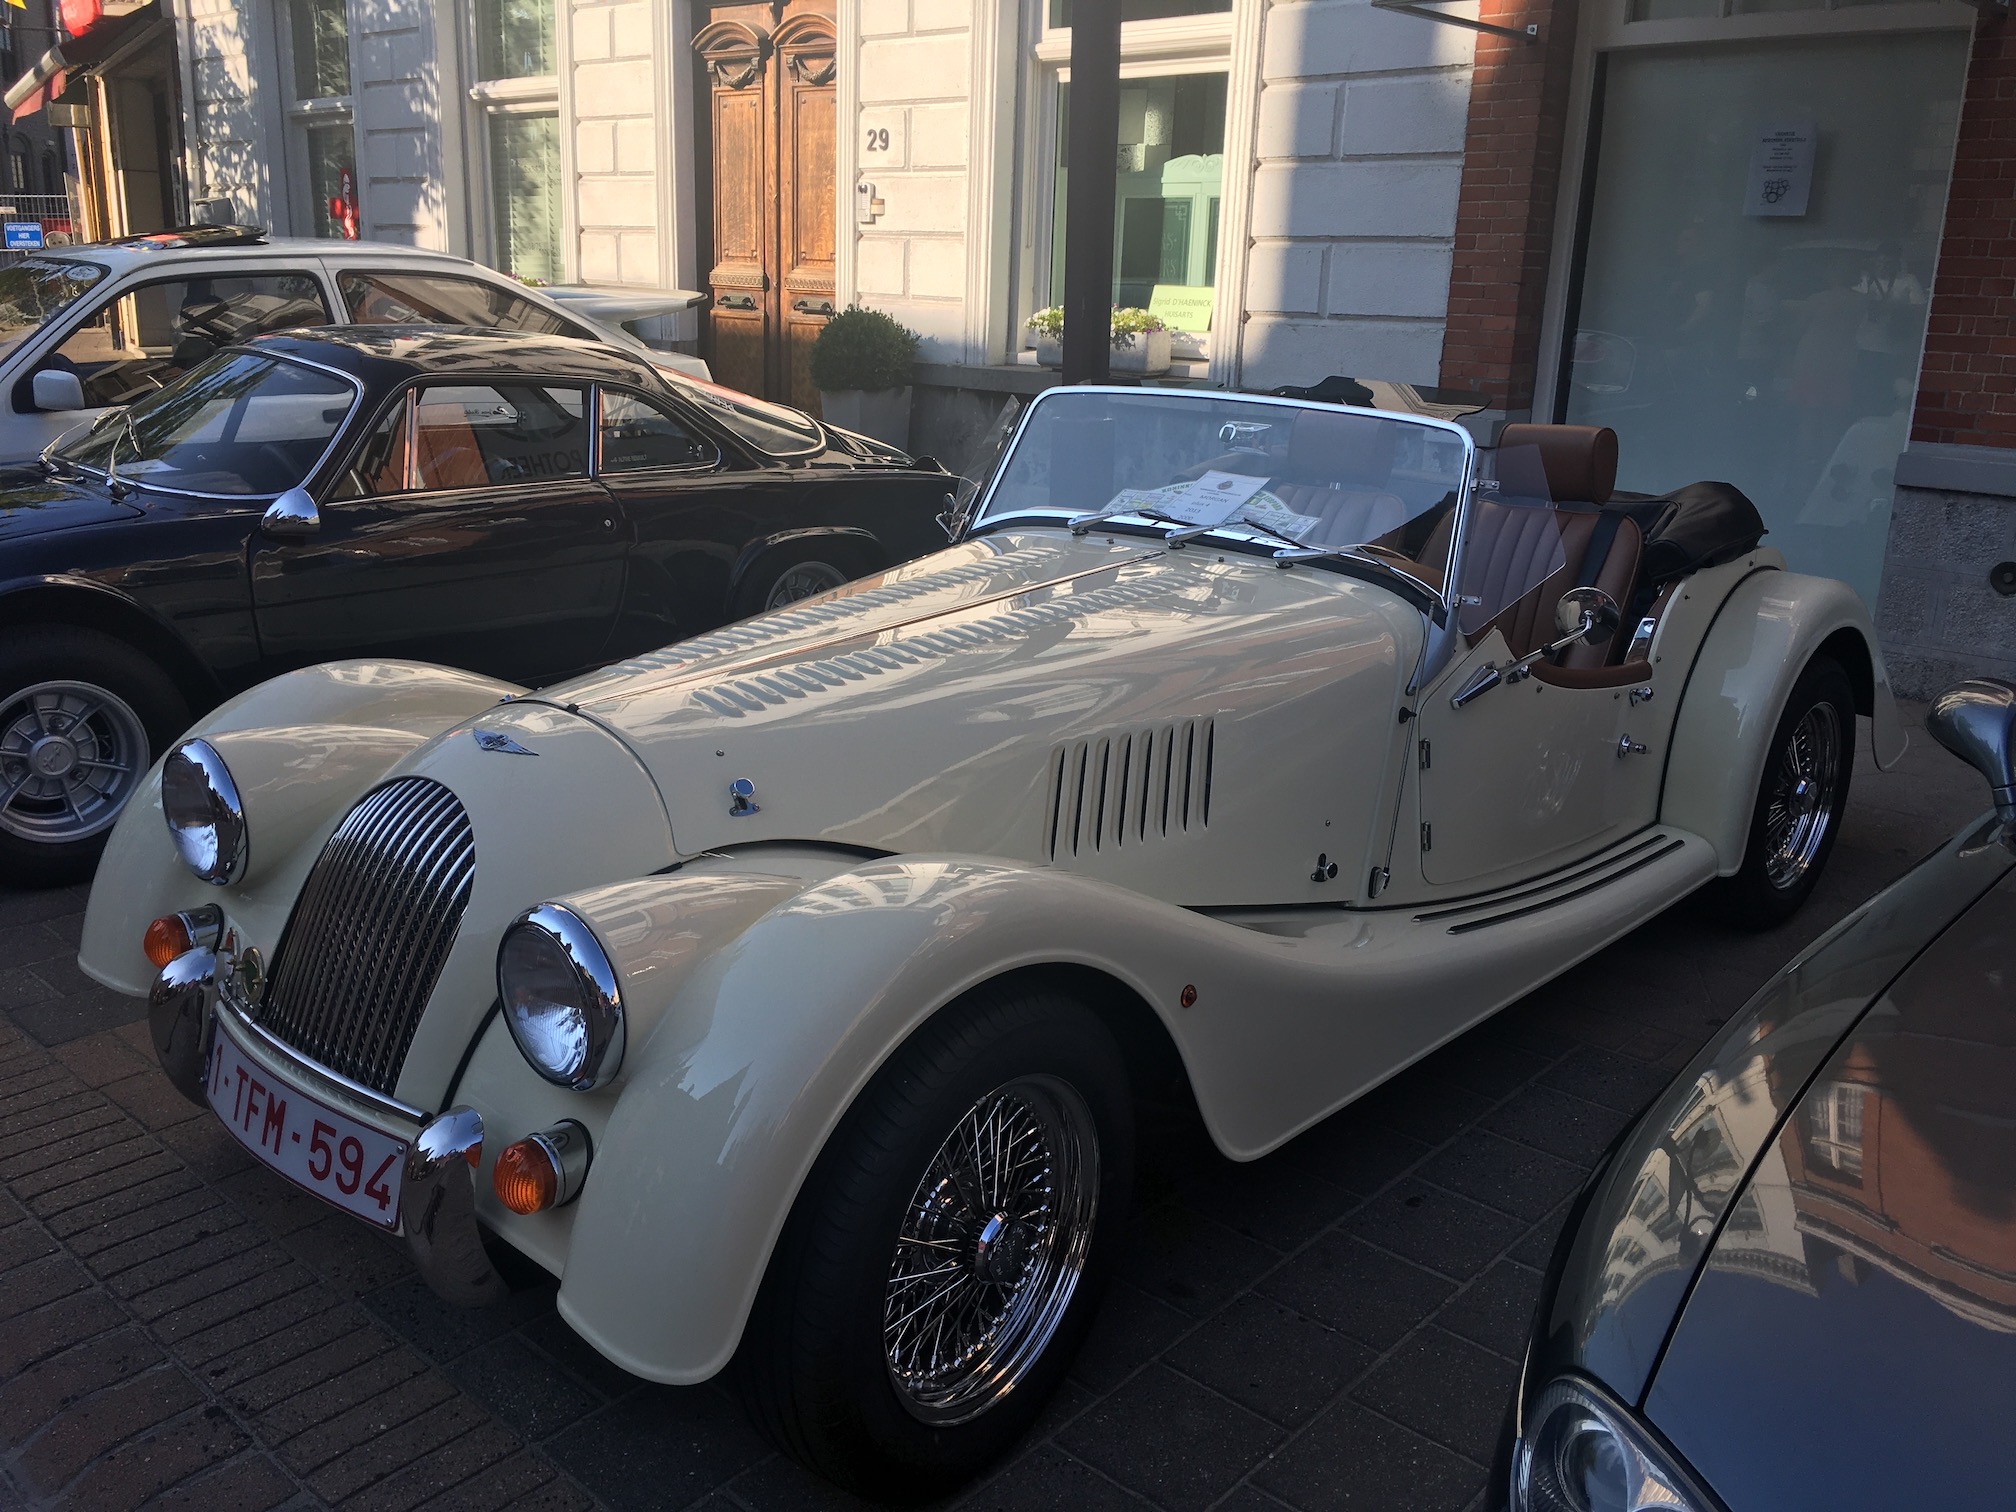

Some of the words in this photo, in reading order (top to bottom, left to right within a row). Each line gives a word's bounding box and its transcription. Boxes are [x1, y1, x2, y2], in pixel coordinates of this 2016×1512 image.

[866, 127, 890, 152] 29
[1153, 297, 1171, 307] Sigrid
[1172, 298, 1212, 308] D'HAENINCK
[1164, 310, 1194, 319] HUISARTS
[1200, 494, 1229, 503] MORGAN
[212, 1043, 398, 1211] 1-TFM-594
